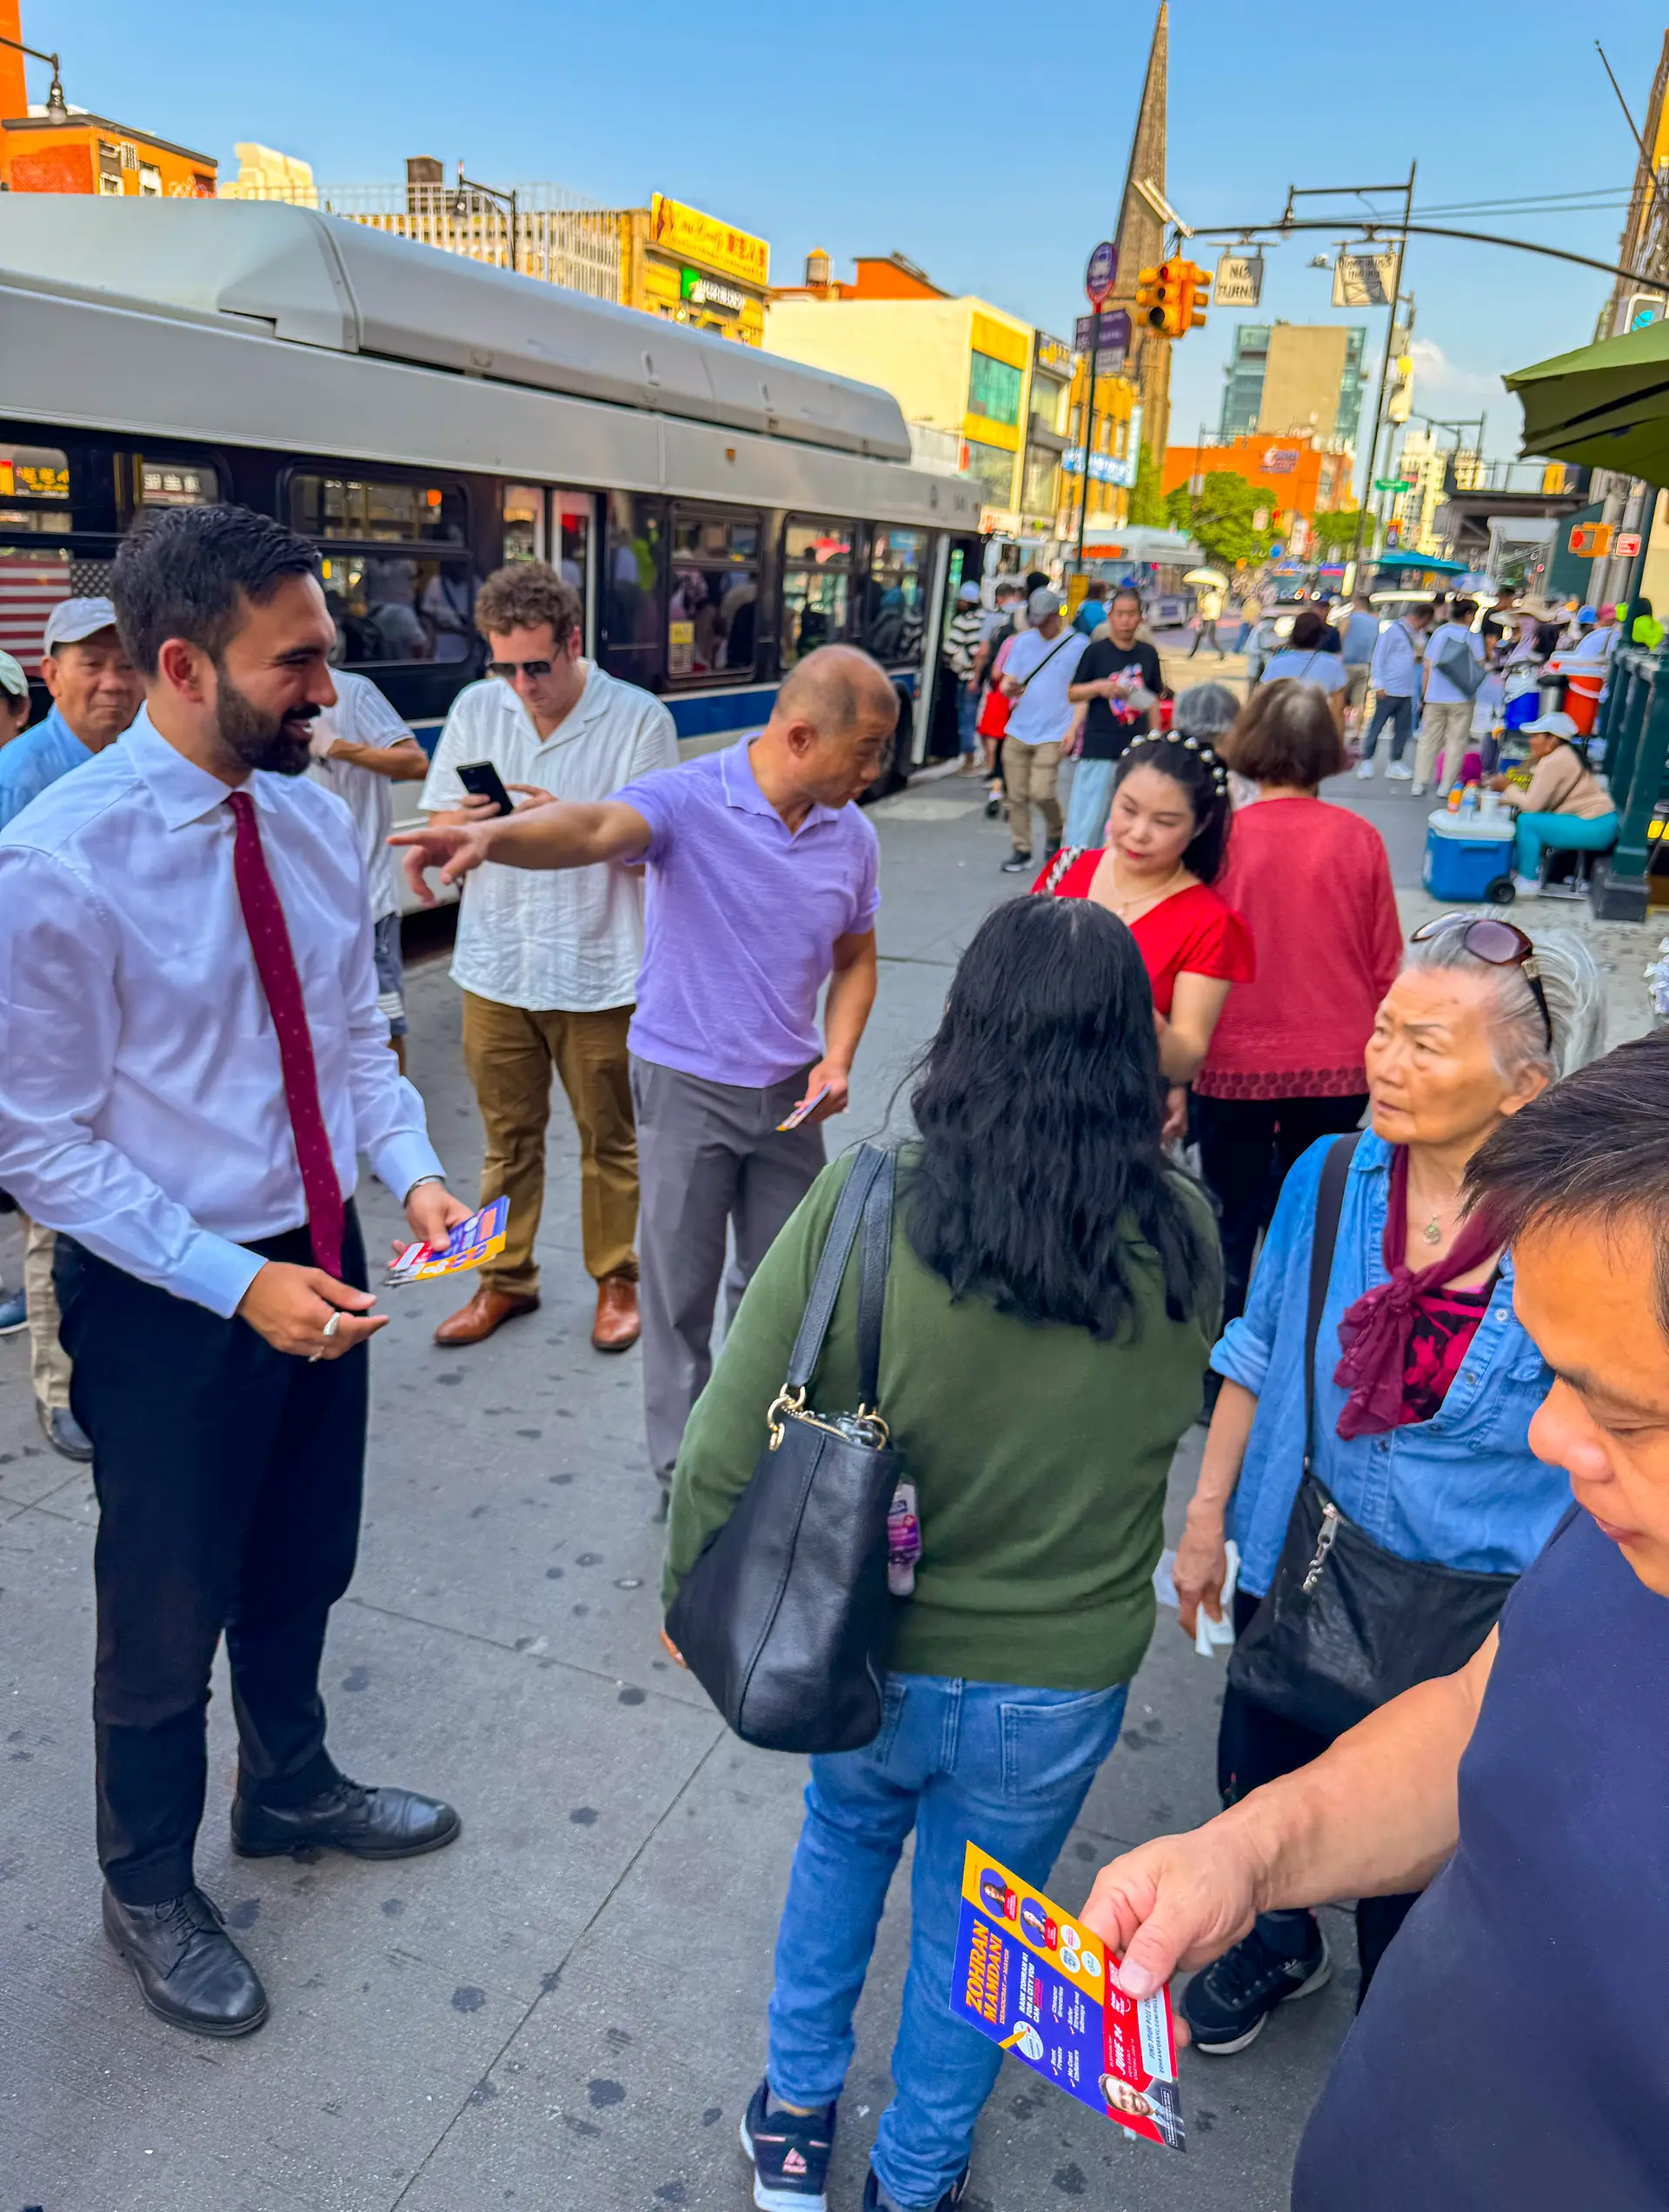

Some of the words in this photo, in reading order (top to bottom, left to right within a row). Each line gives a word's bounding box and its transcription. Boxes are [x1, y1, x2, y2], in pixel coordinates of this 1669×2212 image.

[1229, 264, 1252, 280] NO
[965, 1918, 988, 2015] ZOHRAN
[983, 1932, 1002, 2025] MAMDANI
[1114, 2023, 1123, 2042] 24
[1114, 2038, 1126, 2075] JUNE
[1068, 2067, 1073, 2078] No
